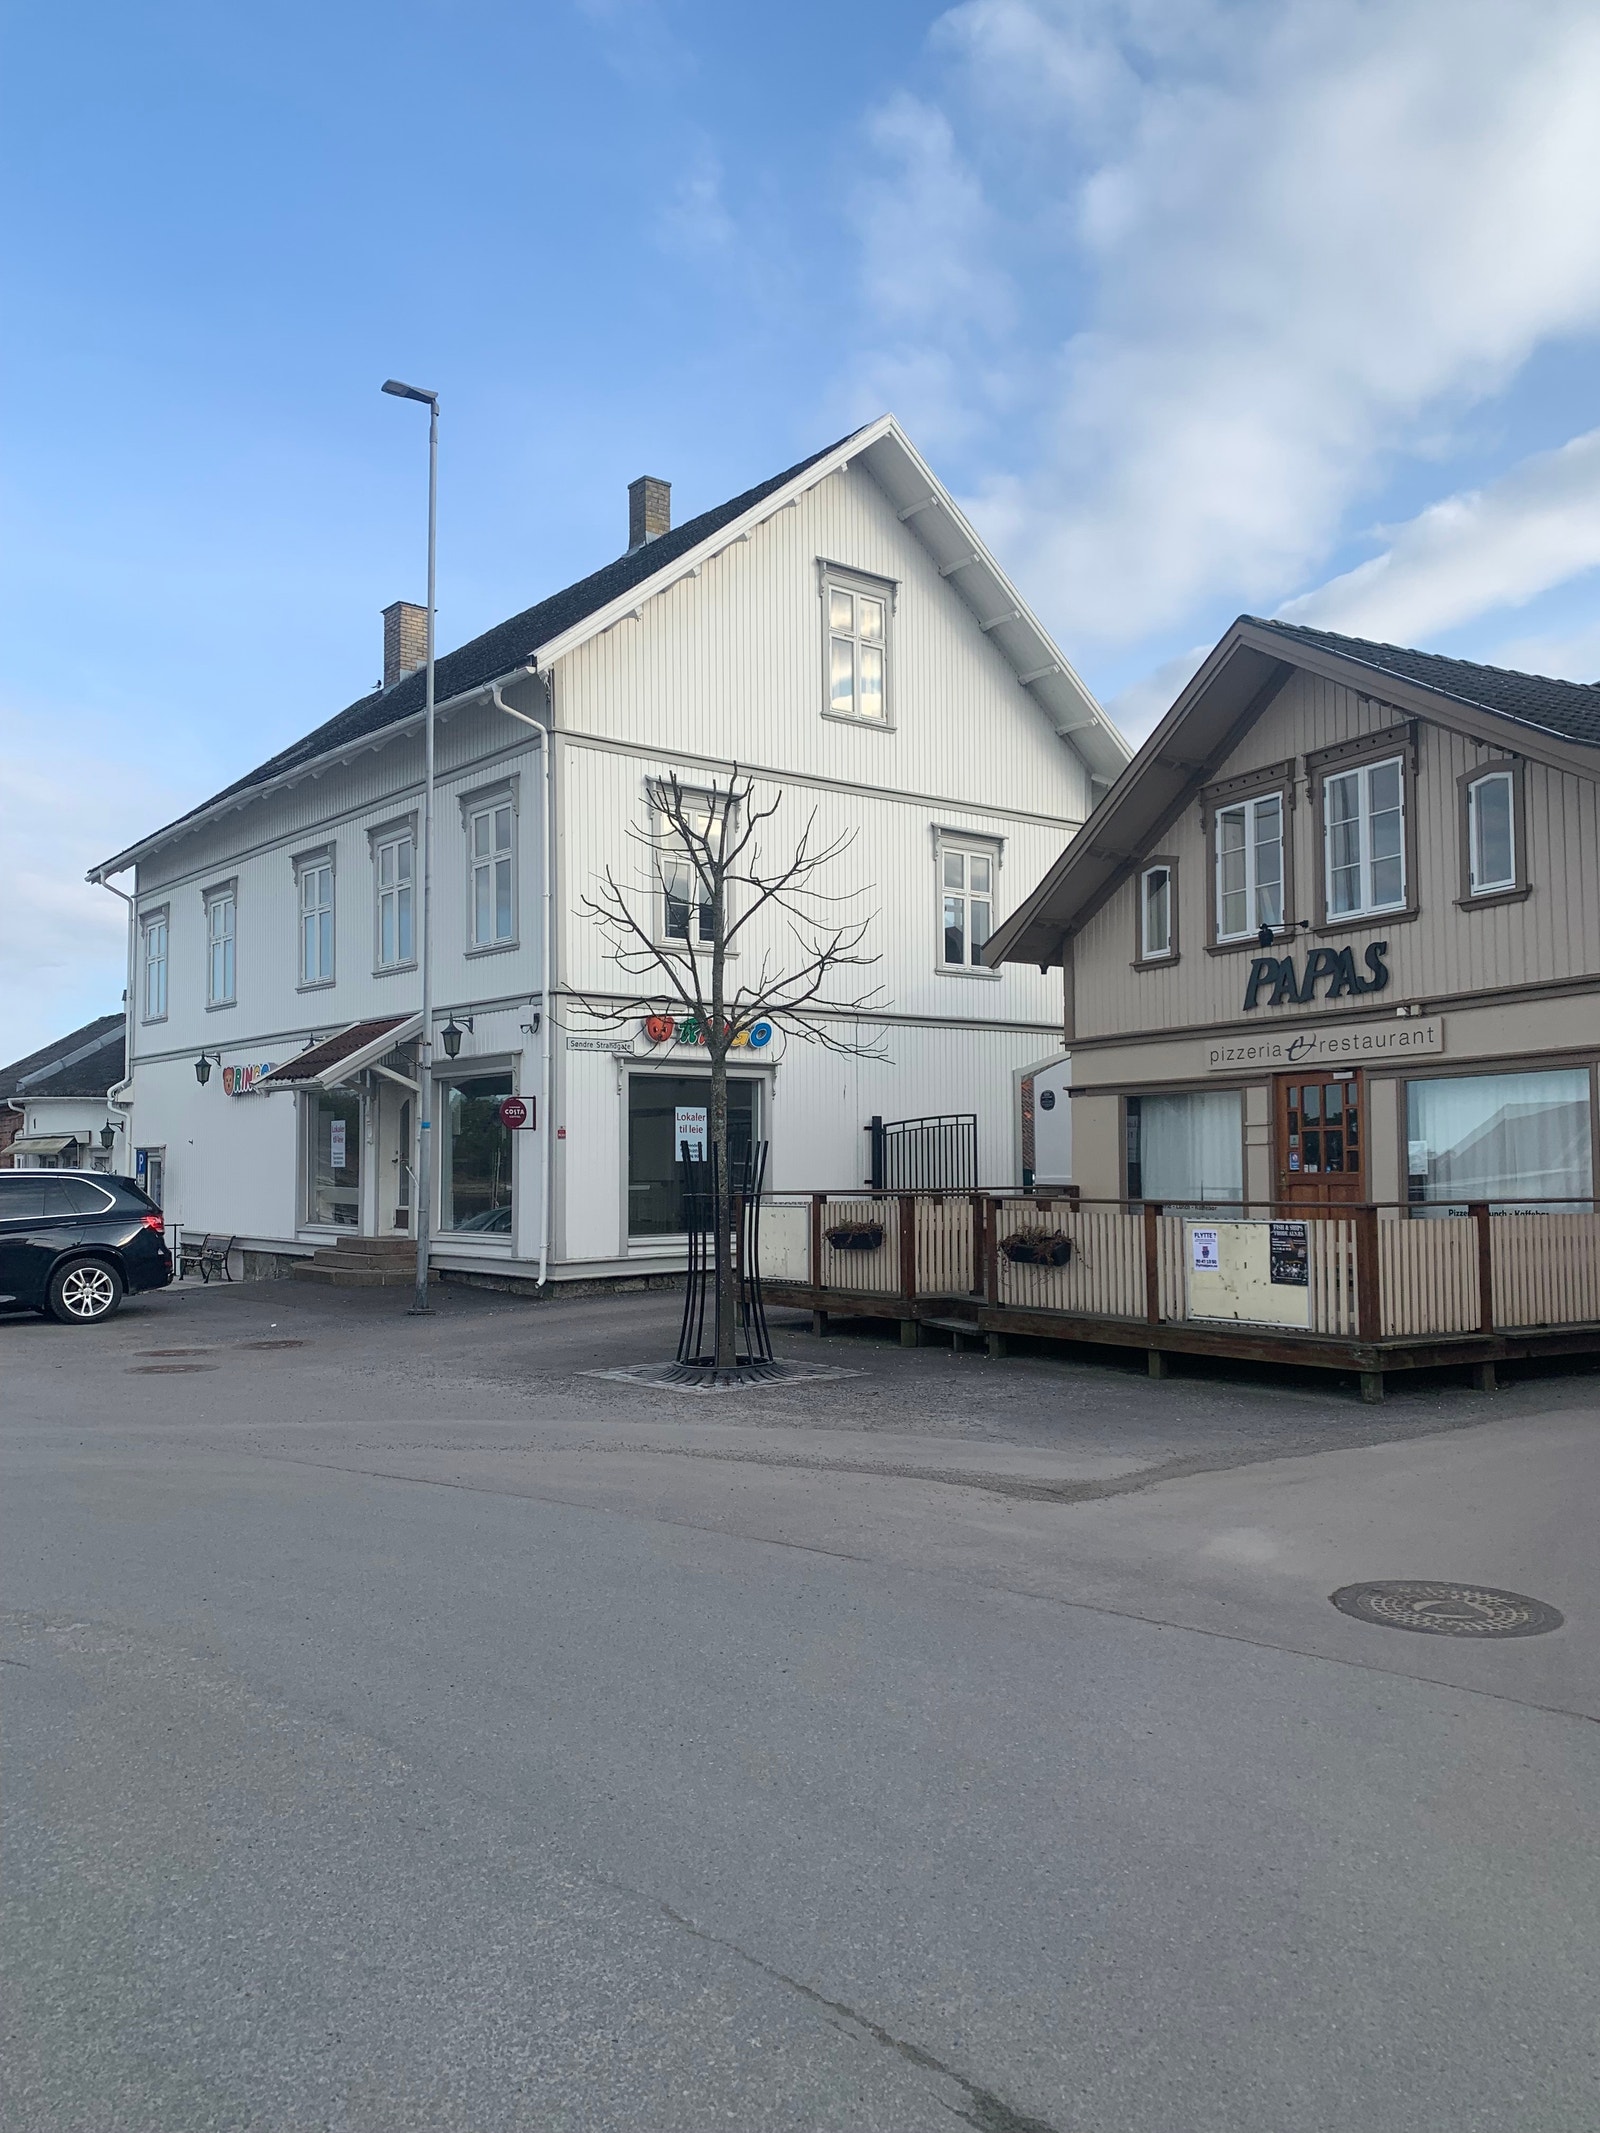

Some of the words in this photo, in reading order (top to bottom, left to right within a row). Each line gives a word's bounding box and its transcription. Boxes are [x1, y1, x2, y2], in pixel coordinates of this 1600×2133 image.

[1242, 941, 1389, 1011] PAPAS
[678, 1017, 773, 1049] RIGO
[570, 1039, 594, 1049] Søndre
[1210, 1042, 1282, 1066] pizzeria
[1319, 1026, 1435, 1053] restaurant
[504, 1108, 525, 1116] COSTA
[676, 1112, 706, 1122] Lokaler
[679, 1125, 688, 1134] til
[689, 1125, 703, 1134] leie
[138, 1154, 144, 1171] P
[1448, 1209, 1469, 1217] Pizze
[1488, 1209, 1507, 1217] unch
